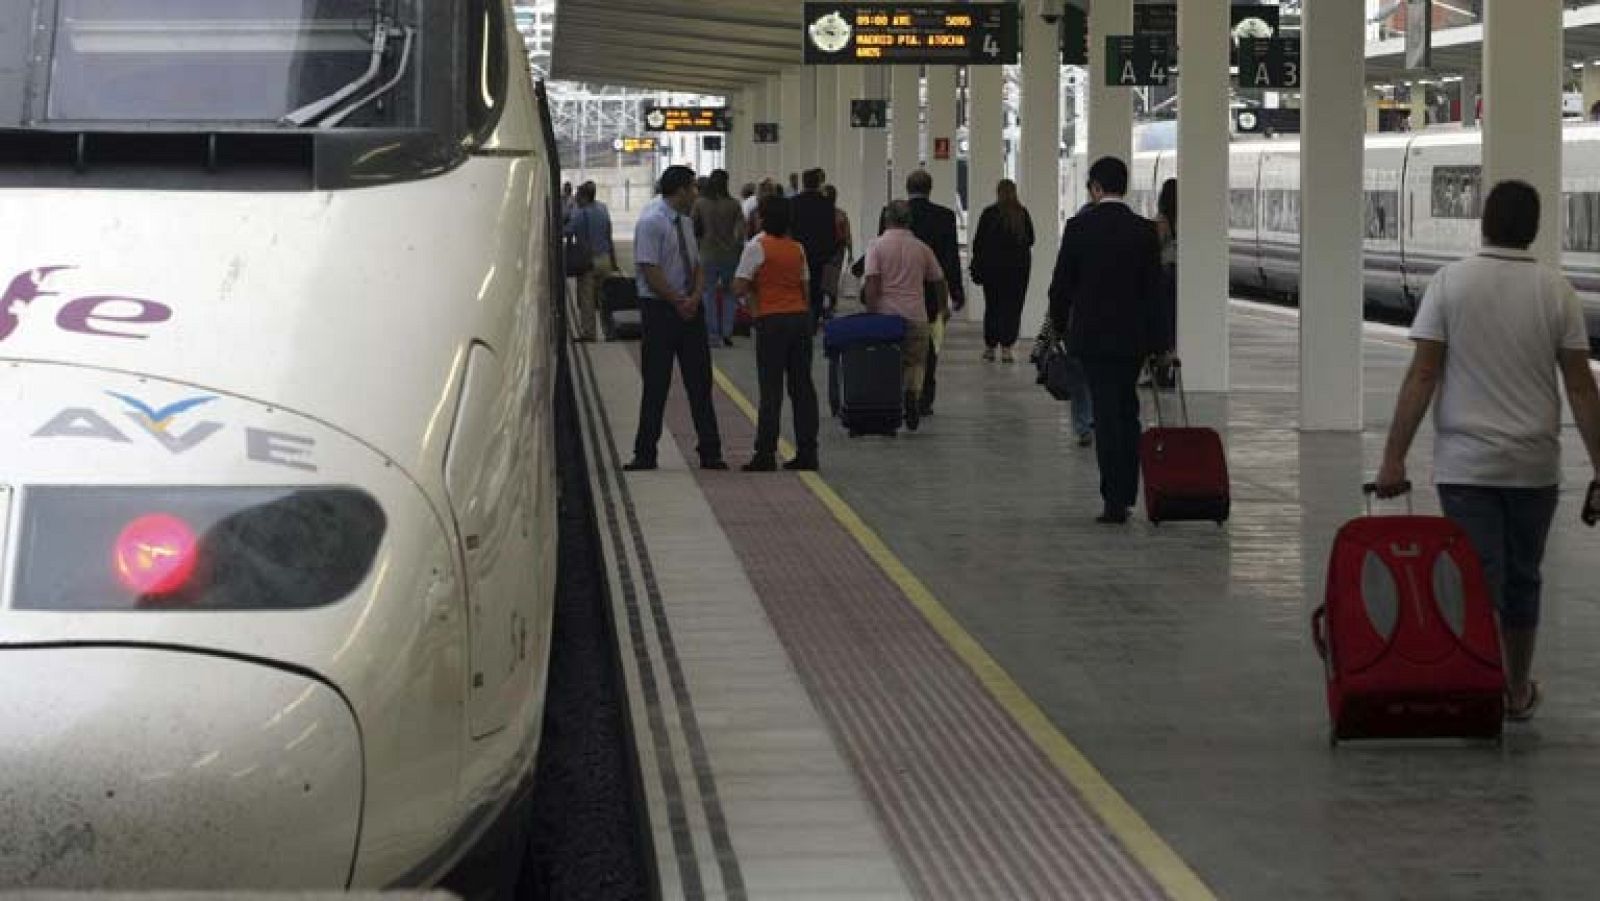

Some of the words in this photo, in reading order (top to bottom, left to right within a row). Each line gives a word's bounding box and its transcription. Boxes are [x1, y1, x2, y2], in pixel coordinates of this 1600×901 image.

[982, 34, 1001, 57] 4
[1120, 59, 1137, 84] A
[1149, 59, 1167, 84] 4
[1255, 62, 1270, 85] A
[1283, 62, 1298, 86] 3
[30, 392, 318, 472] AVE
